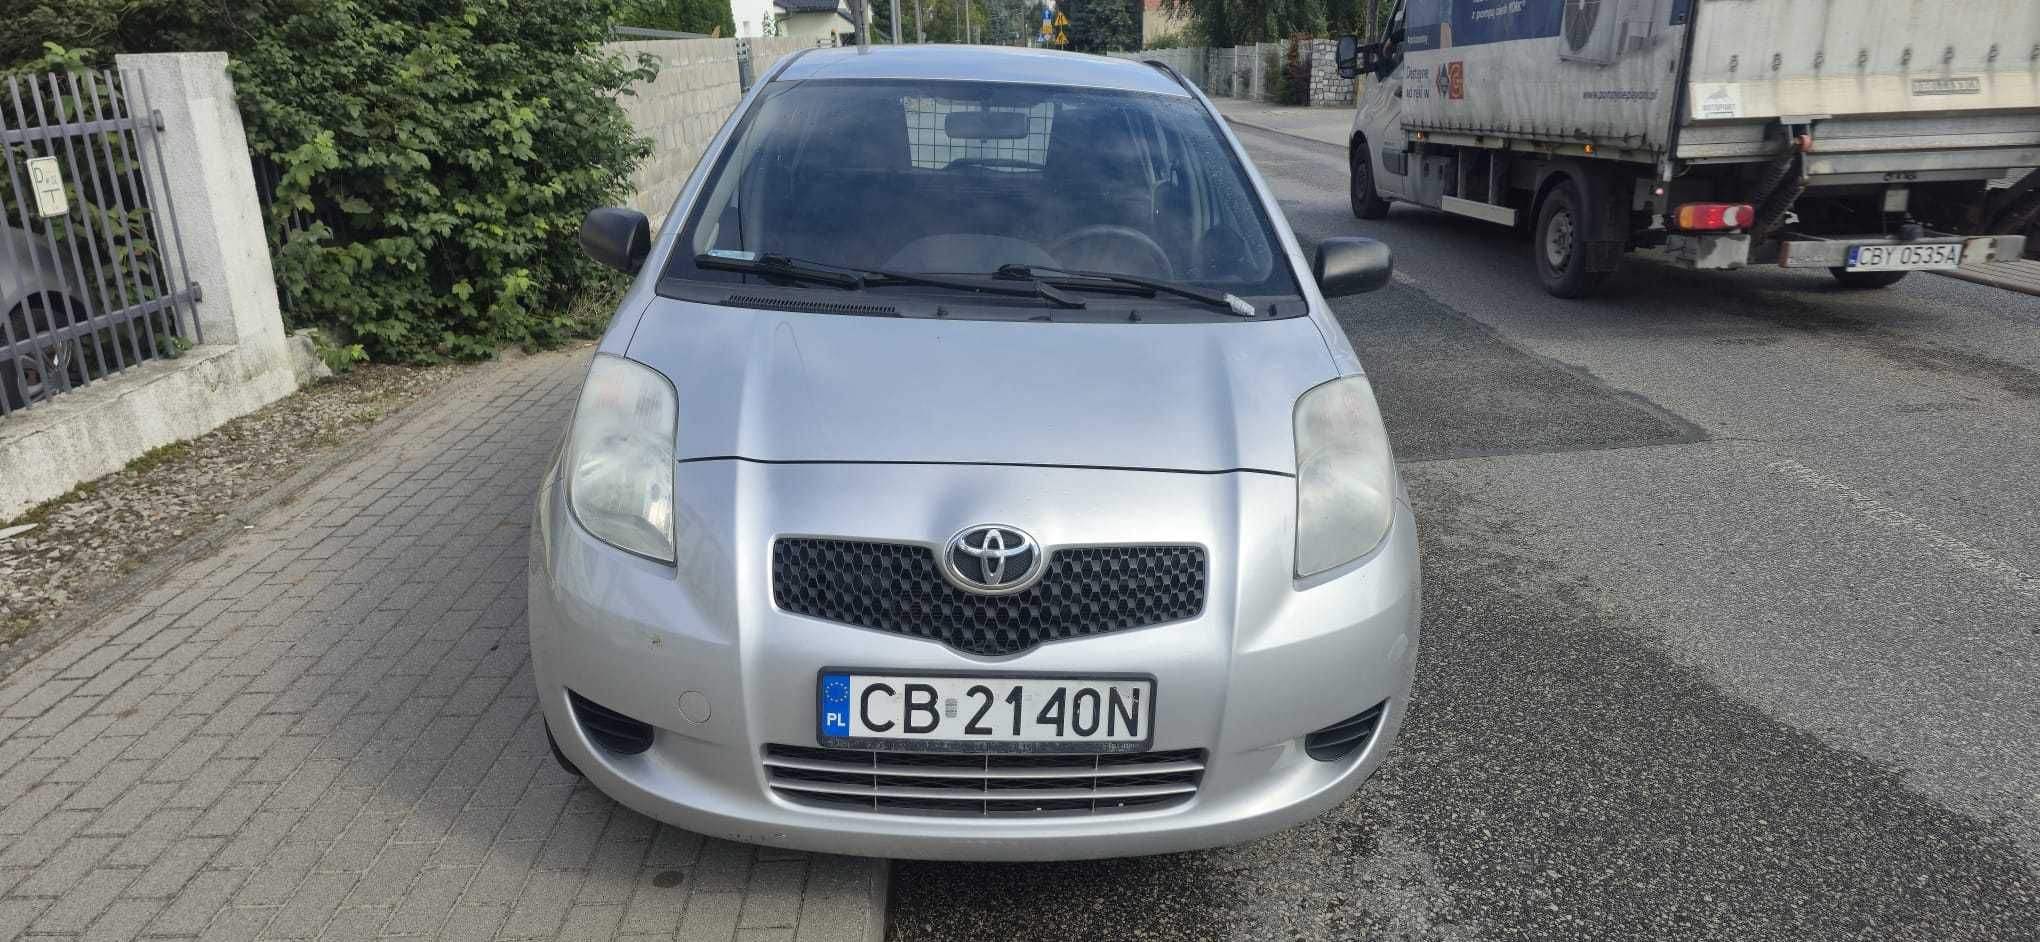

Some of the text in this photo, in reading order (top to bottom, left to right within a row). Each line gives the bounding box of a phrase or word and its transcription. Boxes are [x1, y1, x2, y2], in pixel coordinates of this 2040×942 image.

[1860, 244, 1956, 265] CBY 0535A
[826, 712, 846, 727] PL
[860, 683, 1140, 737] CB 2140N
